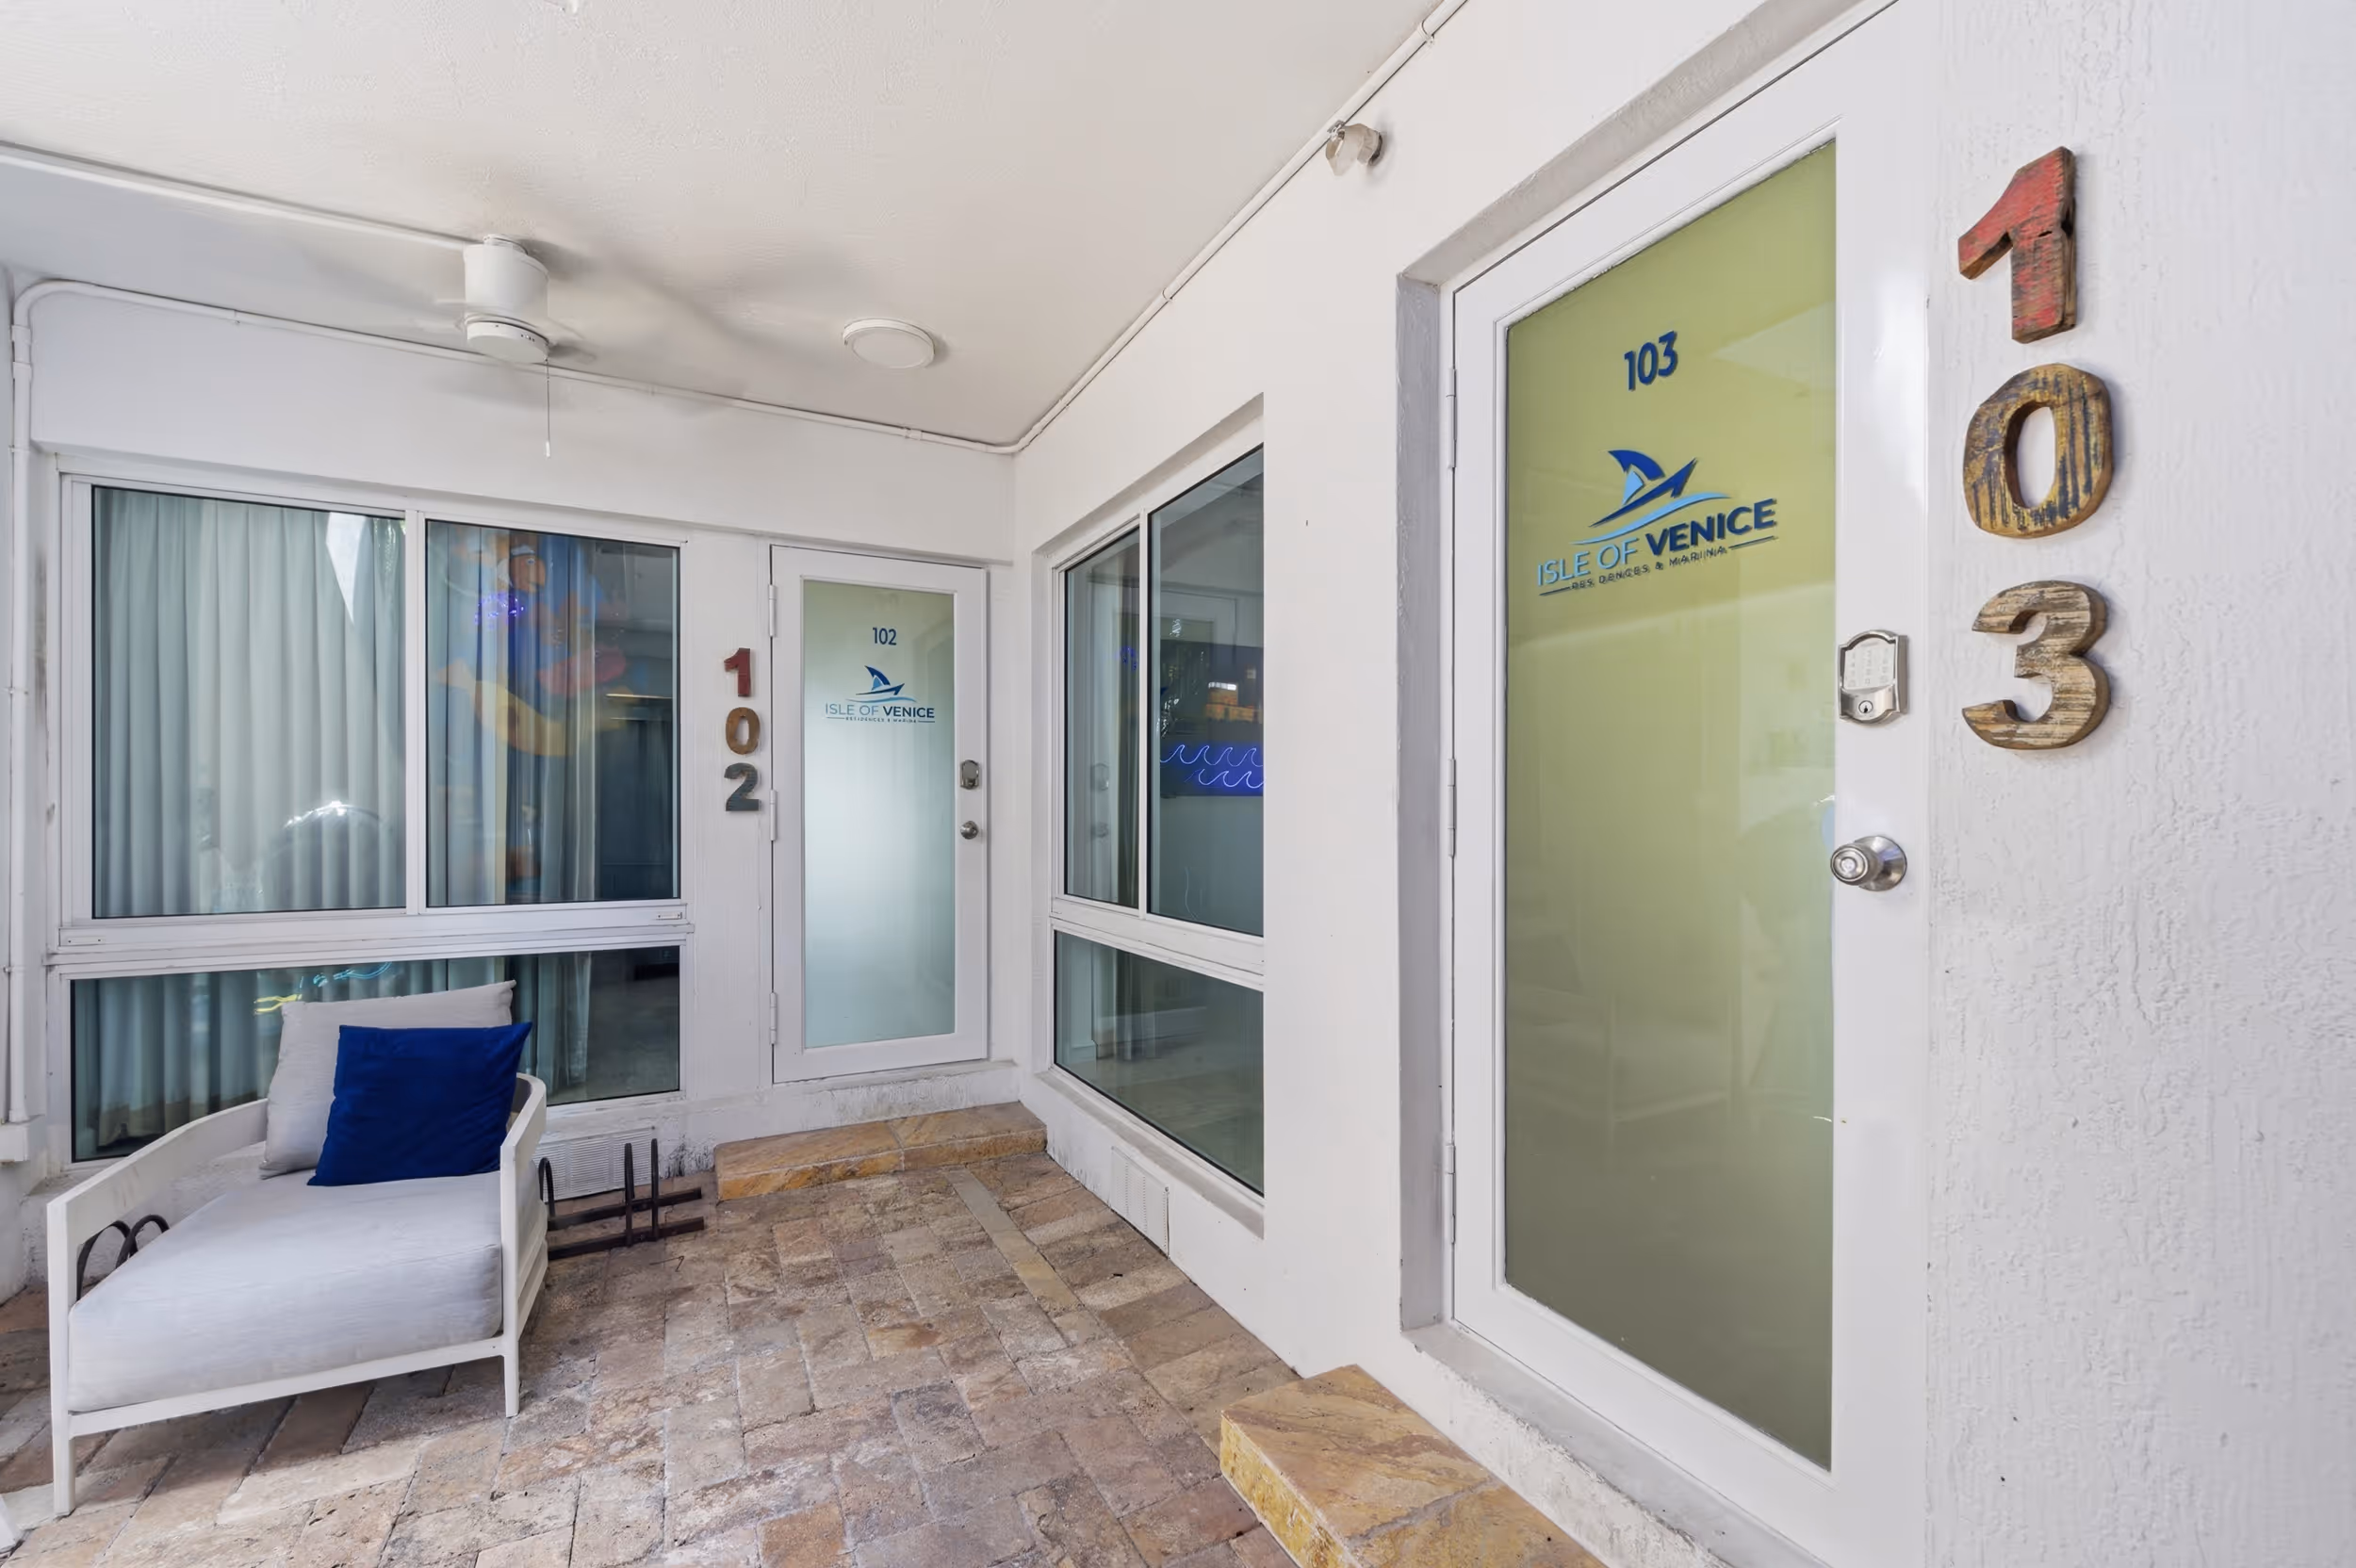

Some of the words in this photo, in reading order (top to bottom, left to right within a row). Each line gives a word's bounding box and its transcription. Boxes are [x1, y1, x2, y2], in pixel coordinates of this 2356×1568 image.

[1624, 330, 1678, 392] 103
[1957, 146, 2114, 749] 103
[1537, 550, 1591, 587] ISLE
[1596, 537, 1640, 570] OF
[1644, 498, 1778, 556] VENICE
[1669, 546, 1727, 567] MARINA
[872, 627, 897, 645] 102
[723, 647, 761, 812] 102
[826, 703, 855, 716] ISLE
[859, 705, 879, 716] OF
[882, 706, 936, 719] VENICE
